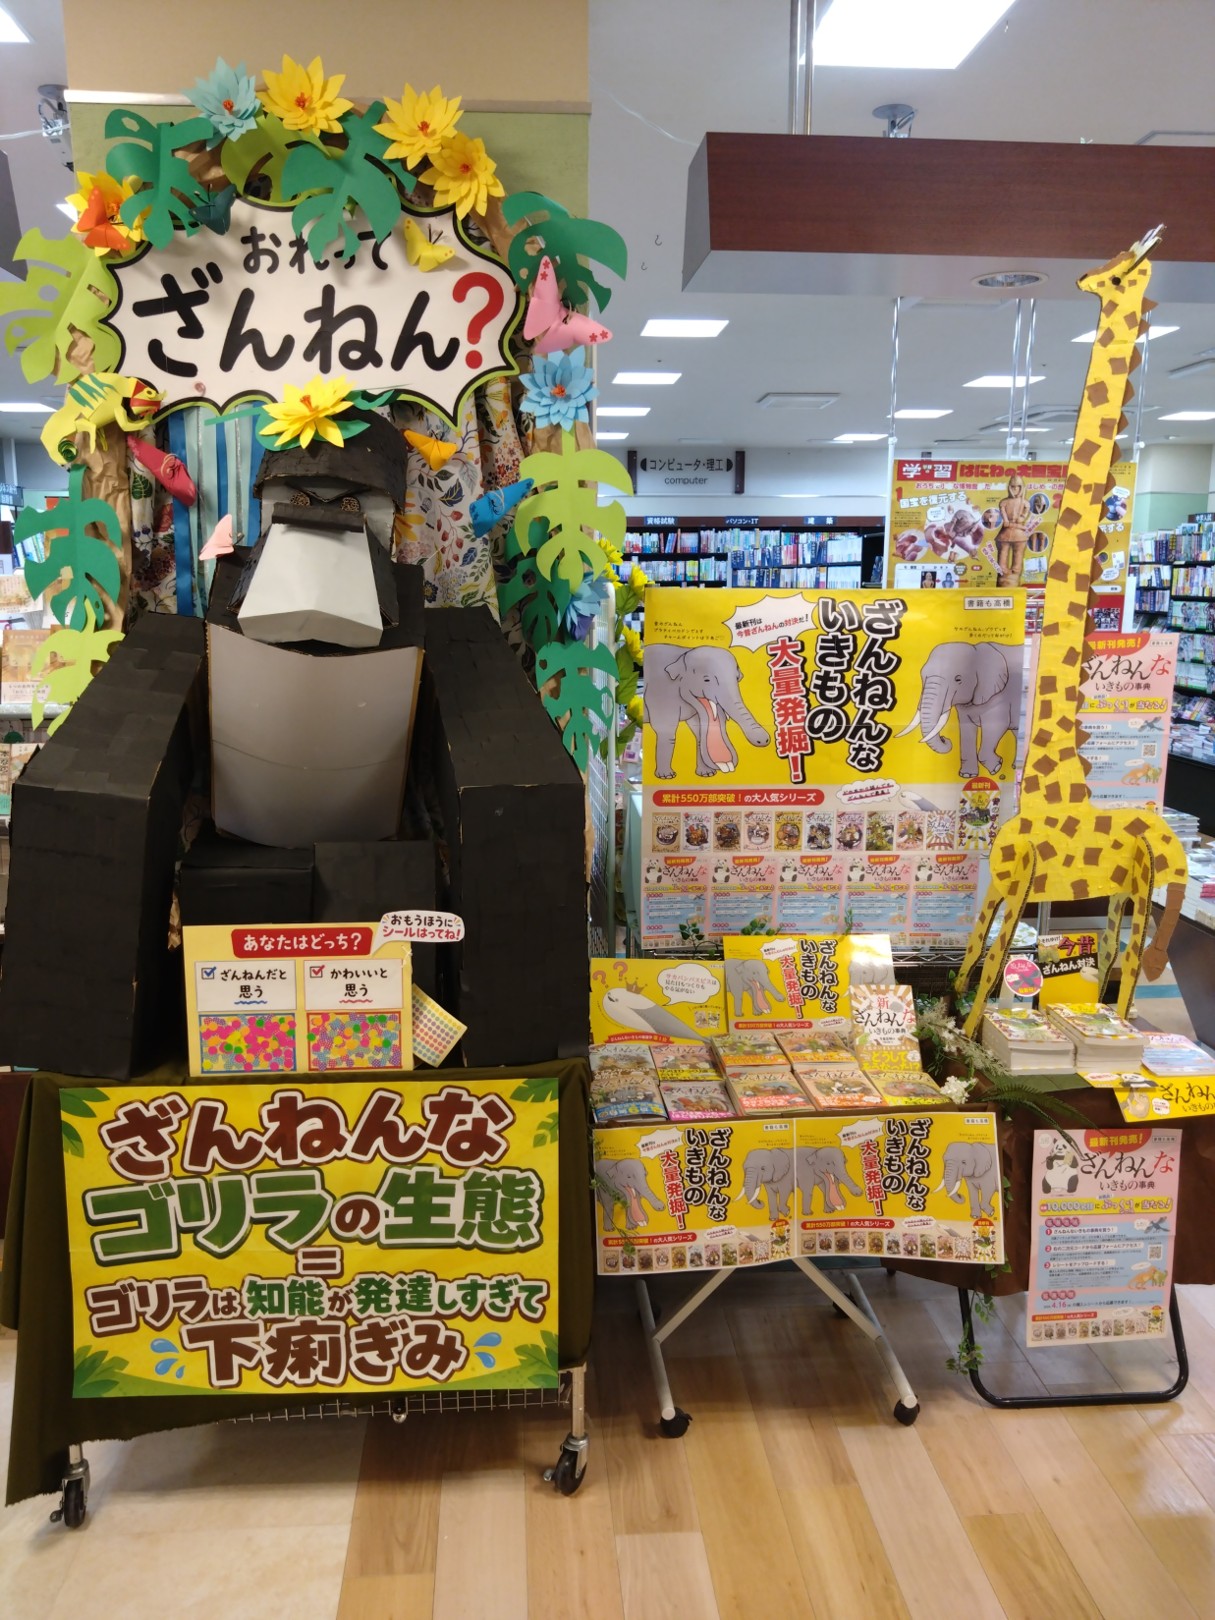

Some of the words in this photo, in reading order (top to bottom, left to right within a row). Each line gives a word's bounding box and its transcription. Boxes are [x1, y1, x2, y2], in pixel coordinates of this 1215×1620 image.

[132, 261, 504, 376] ざんねん?
[650, 458, 724, 471] コンピュータ・理工
[664, 476, 708, 486] computer
[735, 618, 762, 630] 最新刊は
[736, 614, 809, 639] 今昔ざんねんの対決だ!
[806, 597, 863, 742] いきもの
[848, 598, 906, 772] ざんねんな
[1095, 681, 1151, 692] いきもの事典
[767, 637, 811, 783] 大量発掘!
[390, 914, 454, 928] おもうほうに
[243, 931, 363, 952] あなたはどっち?
[382, 926, 462, 941] シールはってね!
[1058, 935, 1095, 956] 今昔
[220, 968, 288, 982] ざんねんだと
[330, 967, 389, 980] かわいいと
[800, 939, 818, 1000] いきもの
[819, 940, 838, 1013] ざんねんな
[1043, 957, 1096, 975] ざんねん対決
[239, 985, 263, 999] 思う
[344, 983, 369, 998] 思う
[877, 996, 889, 1009] 新
[855, 1009, 915, 1027] ざんねんな
[1183, 1102, 1215, 1112] いきもの
[101, 1088, 514, 1181] ざんねんな
[684, 1128, 709, 1206] いきもの
[882, 1118, 908, 1194] いきもの
[906, 1117, 933, 1211] ざんねんな
[1080, 1150, 1175, 1180] ざんねんな
[707, 1127, 732, 1222] ざんねんな
[860, 1139, 886, 1216] 大量発掘!
[1100, 1180, 1156, 1191] いきもの事典
[660, 1150, 688, 1230] 大量発掘!
[85, 1166, 543, 1264] ゴリラの生態
[183, 1318, 467, 1386] 下痢ぎみ
